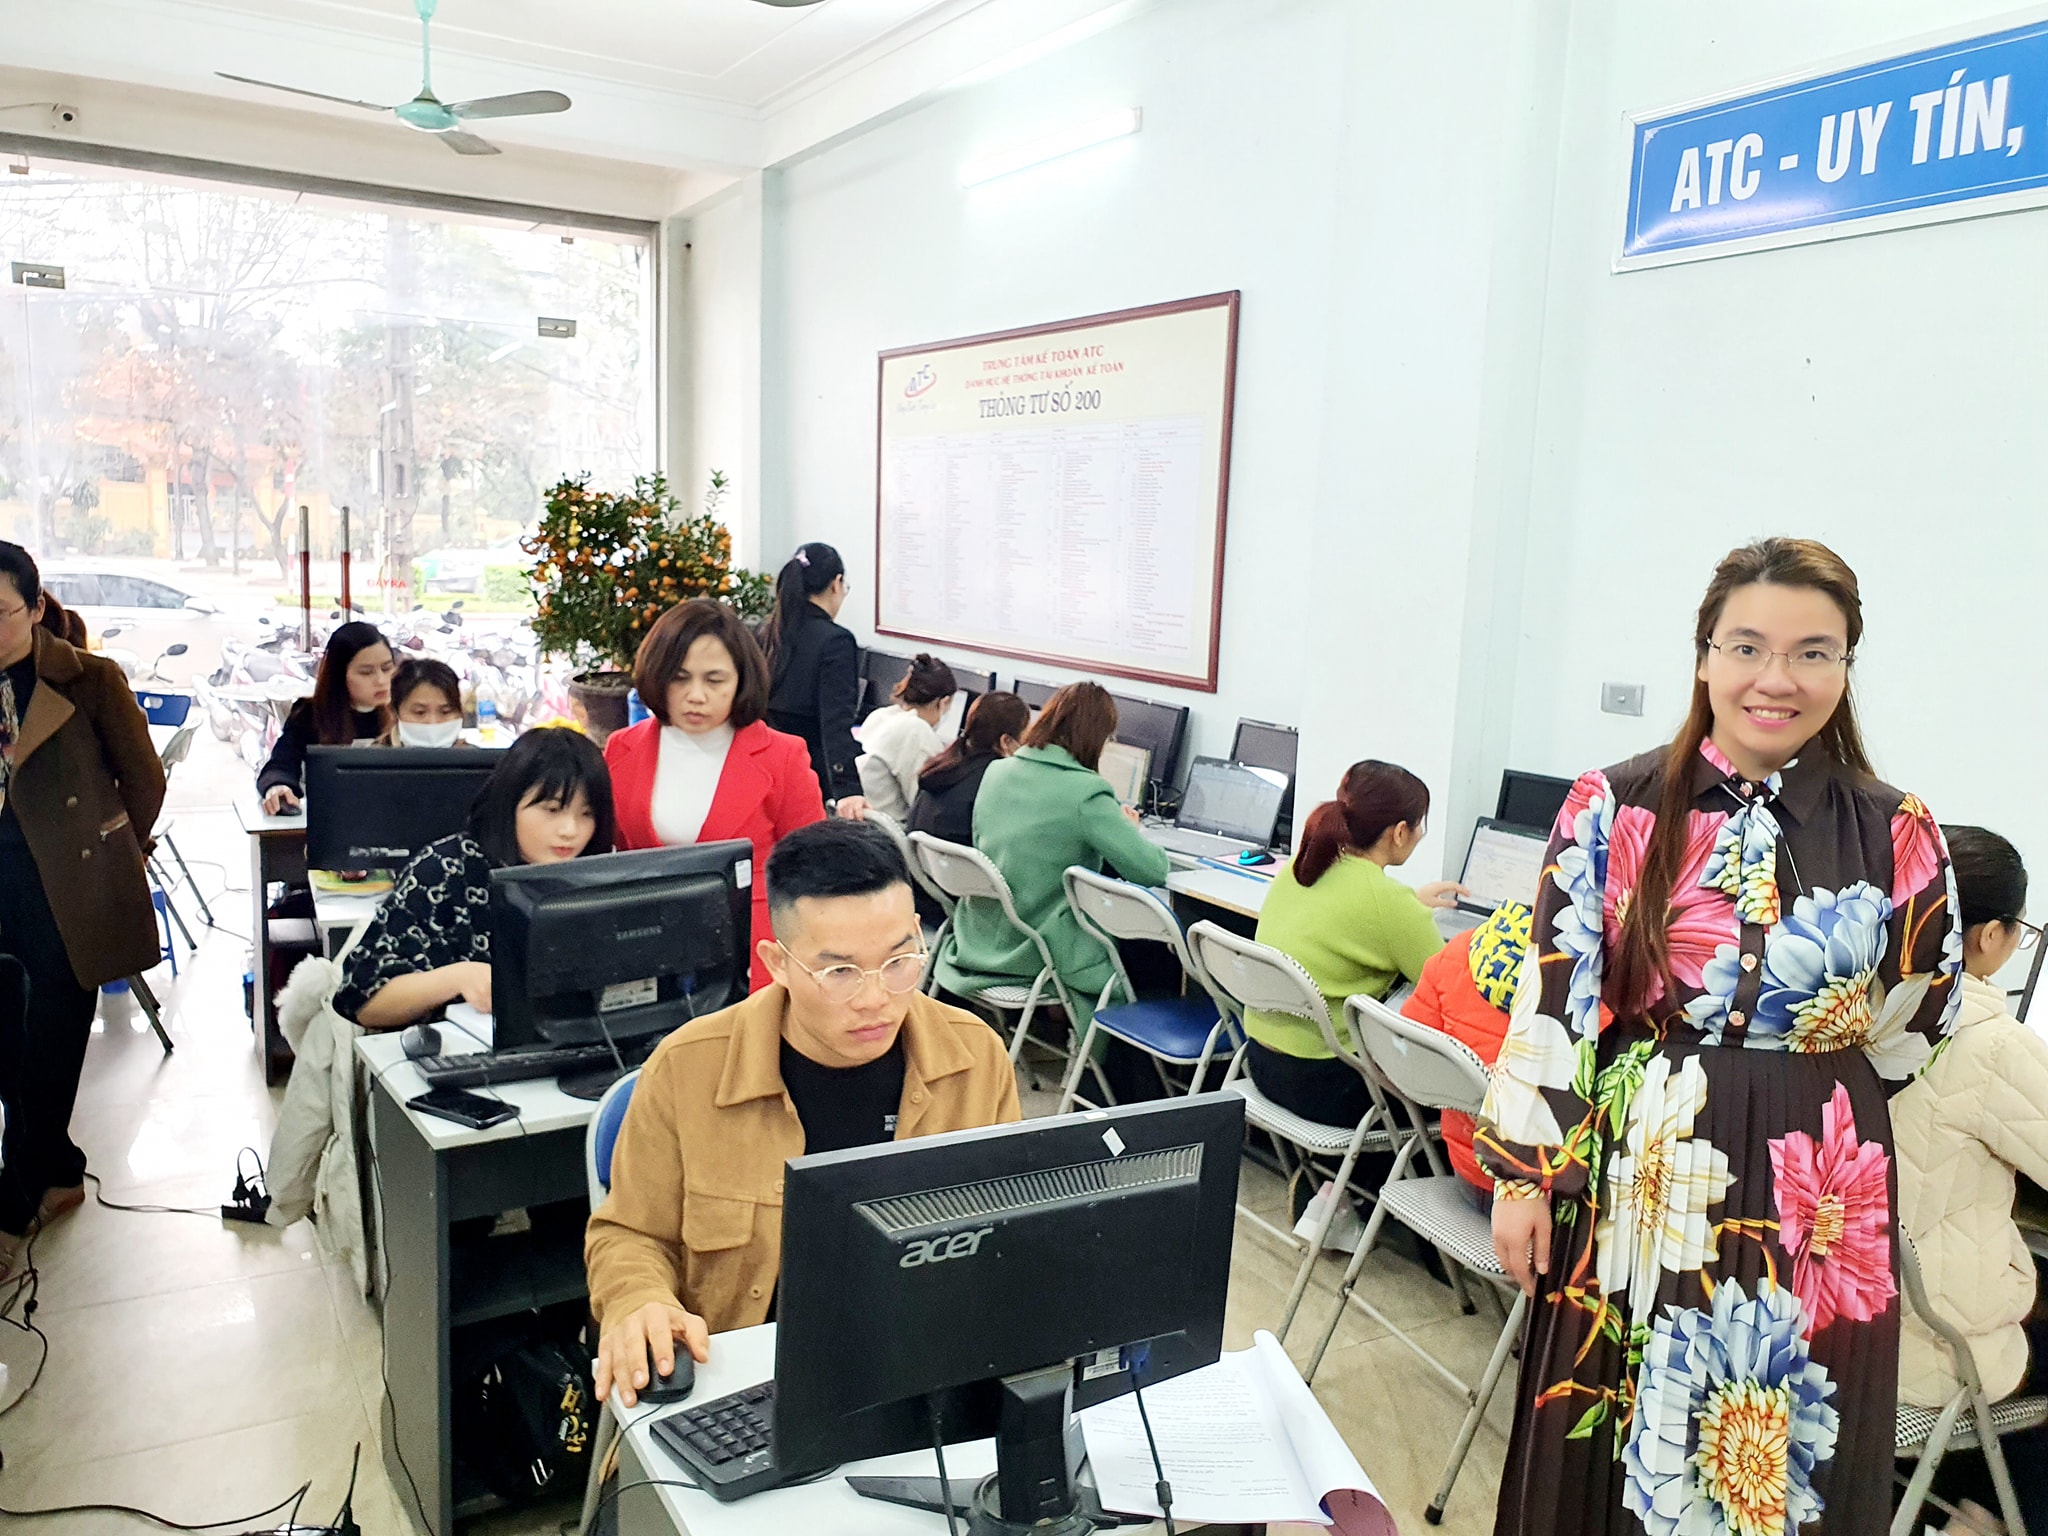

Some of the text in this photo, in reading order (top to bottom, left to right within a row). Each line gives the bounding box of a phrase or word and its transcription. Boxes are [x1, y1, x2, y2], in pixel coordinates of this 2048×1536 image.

[1670, 68, 2024, 213] ATC - UY TÍN,
[1083, 344, 1104, 359] ATC
[1075, 389, 1101, 410] 200
[616, 925, 663, 941] SAMSUNG
[899, 1227, 995, 1268] acer
